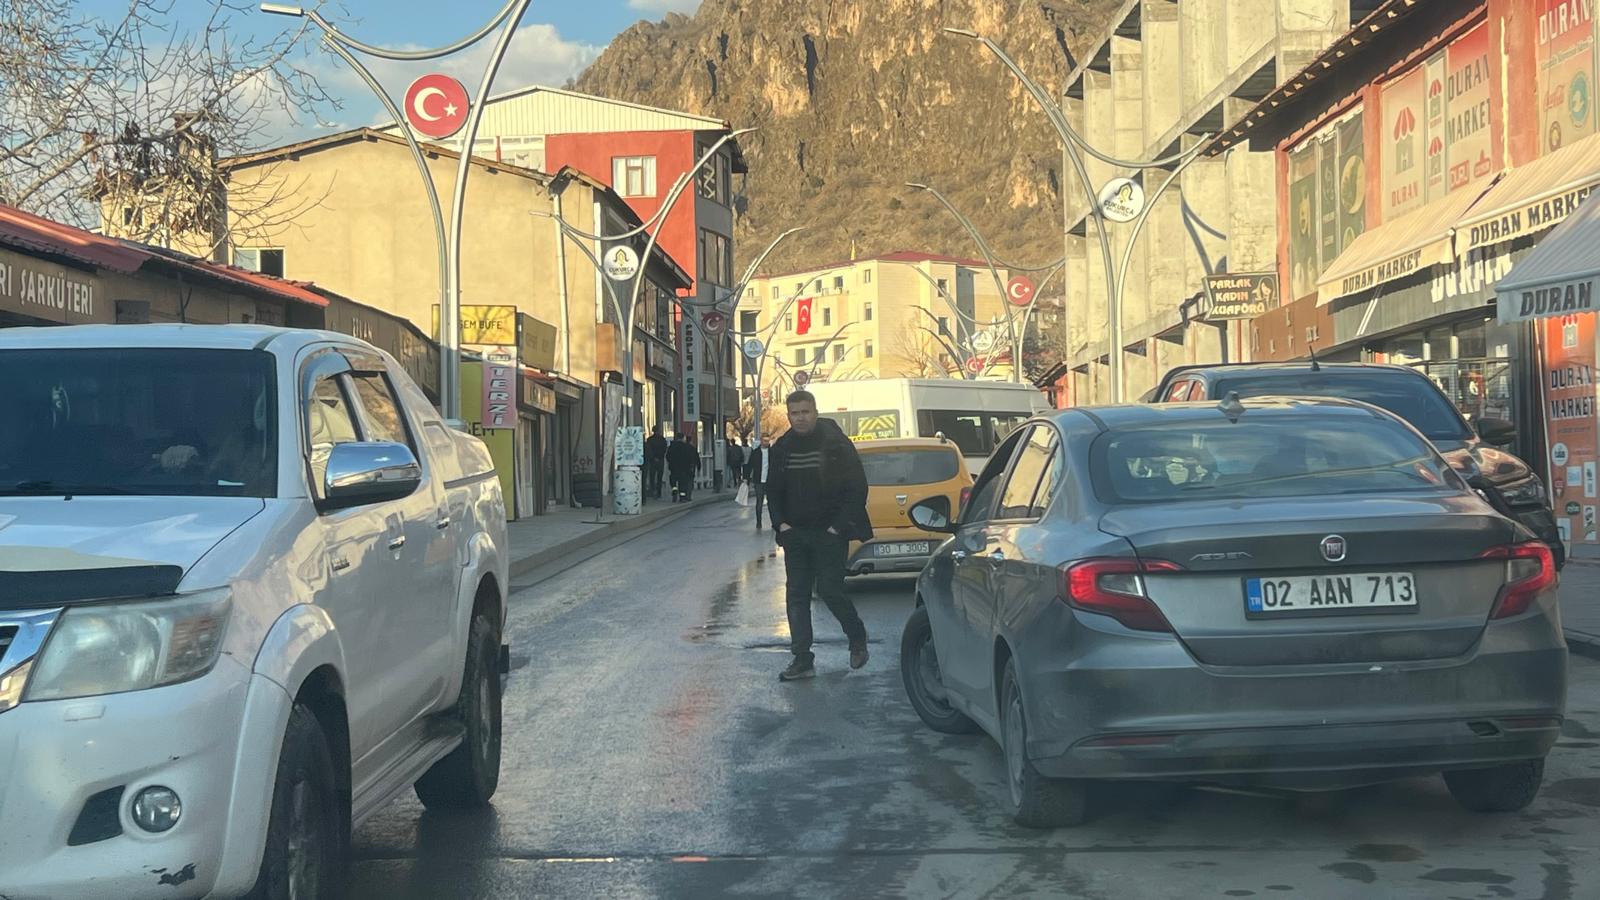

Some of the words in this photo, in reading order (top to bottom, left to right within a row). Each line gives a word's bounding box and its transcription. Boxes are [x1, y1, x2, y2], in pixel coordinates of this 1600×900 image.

[1539, 0, 1593, 46] DURAN
[1447, 54, 1489, 102] DURAN
[1469, 211, 1521, 247] DURAN
[1528, 185, 1595, 228] MARKE
[1210, 278, 1252, 290] PARLAK
[1342, 268, 1374, 295] DURAN
[1376, 249, 1421, 283] MARKET
[20, 269, 93, 315] ŞARKÜTERİ
[1215, 291, 1249, 302] KADIN
[1520, 281, 1592, 317] DURAN
[1552, 365, 1592, 390] DURAN
[1552, 396, 1595, 420] MARKET
[880, 545, 891, 554] 30
[896, 544, 903, 553] T
[906, 542, 928, 553] 3005
[1263, 581, 1293, 607] 02
[1310, 578, 1354, 605] AAN
[1367, 576, 1413, 603] 713
